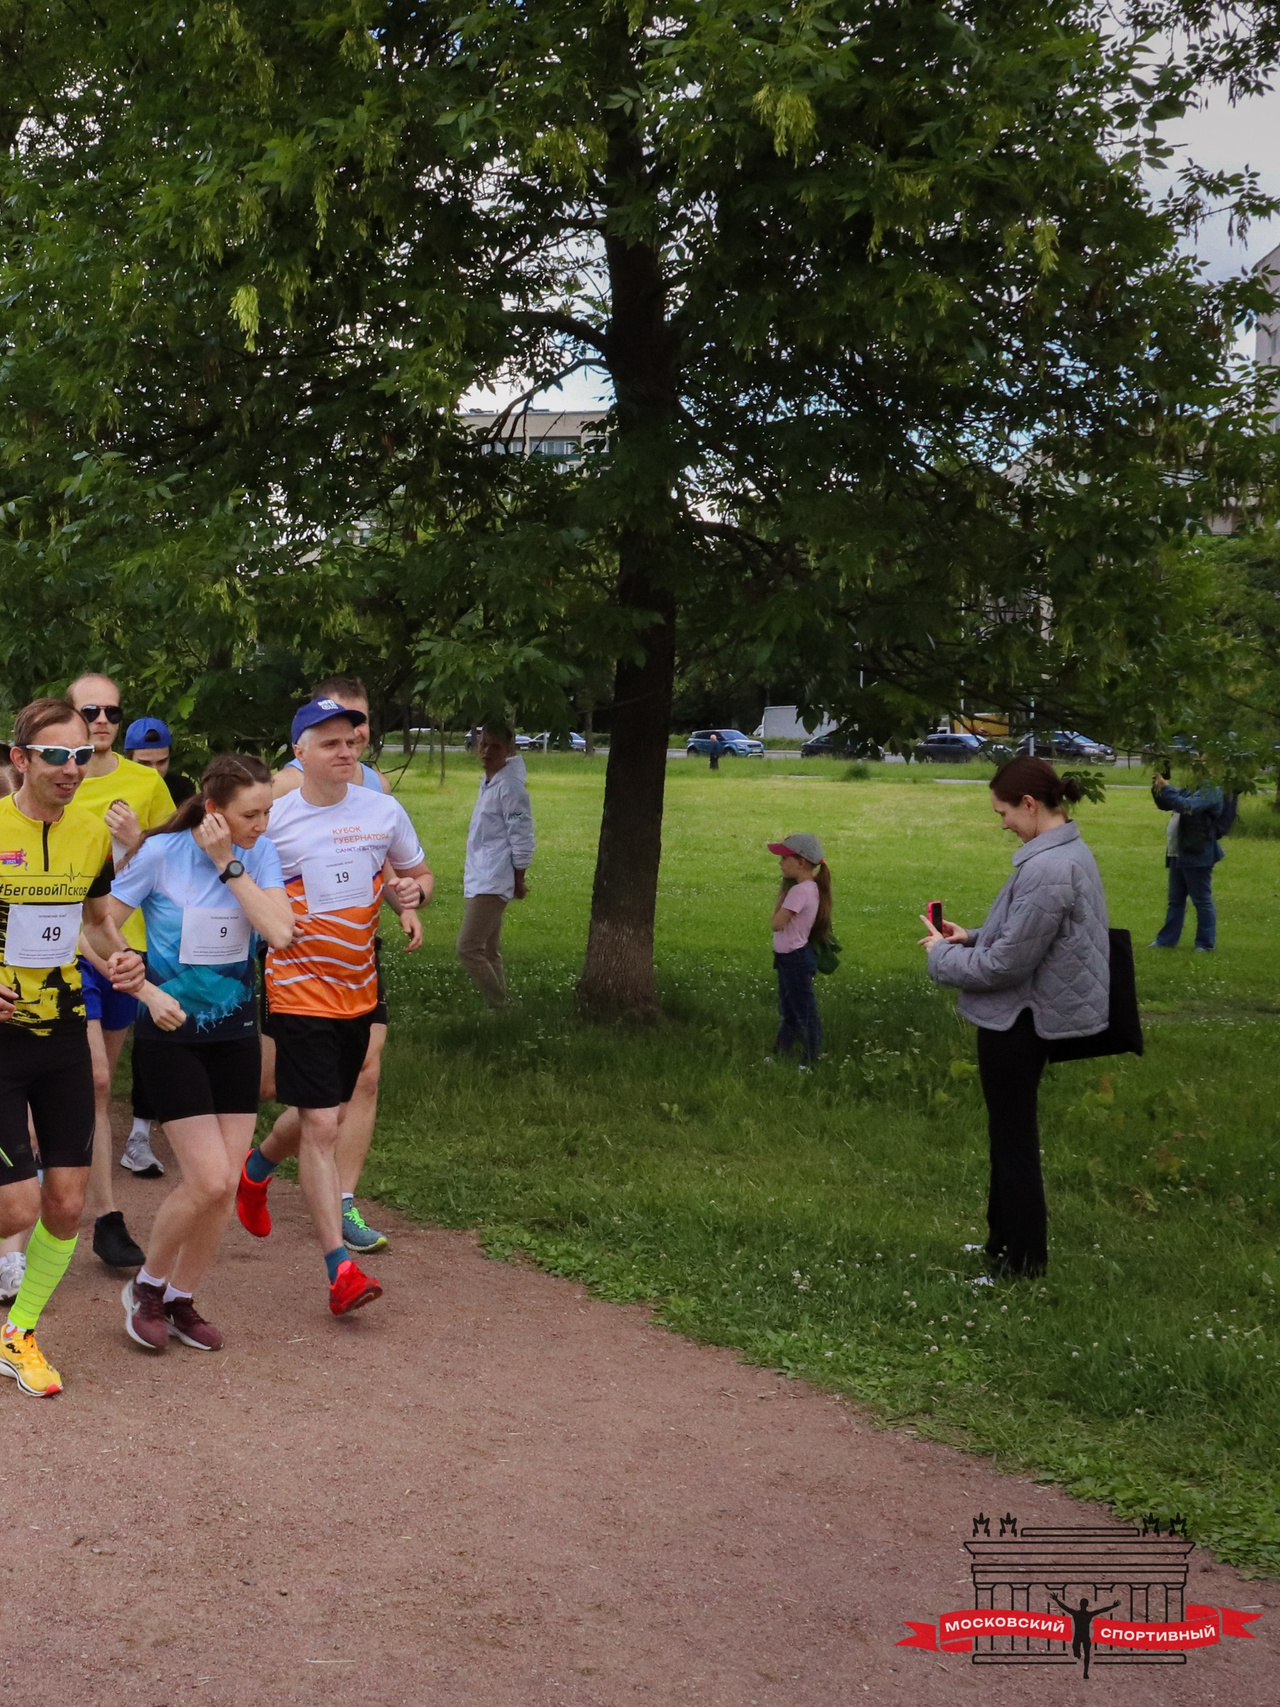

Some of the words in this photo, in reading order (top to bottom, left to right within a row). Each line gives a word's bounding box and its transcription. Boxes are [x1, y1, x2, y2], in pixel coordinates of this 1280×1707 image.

[332, 826, 362, 835] КУБОК
[335, 871, 350, 883] 19
[41, 926, 61, 941] 49
[220, 926, 228, 938] 9
